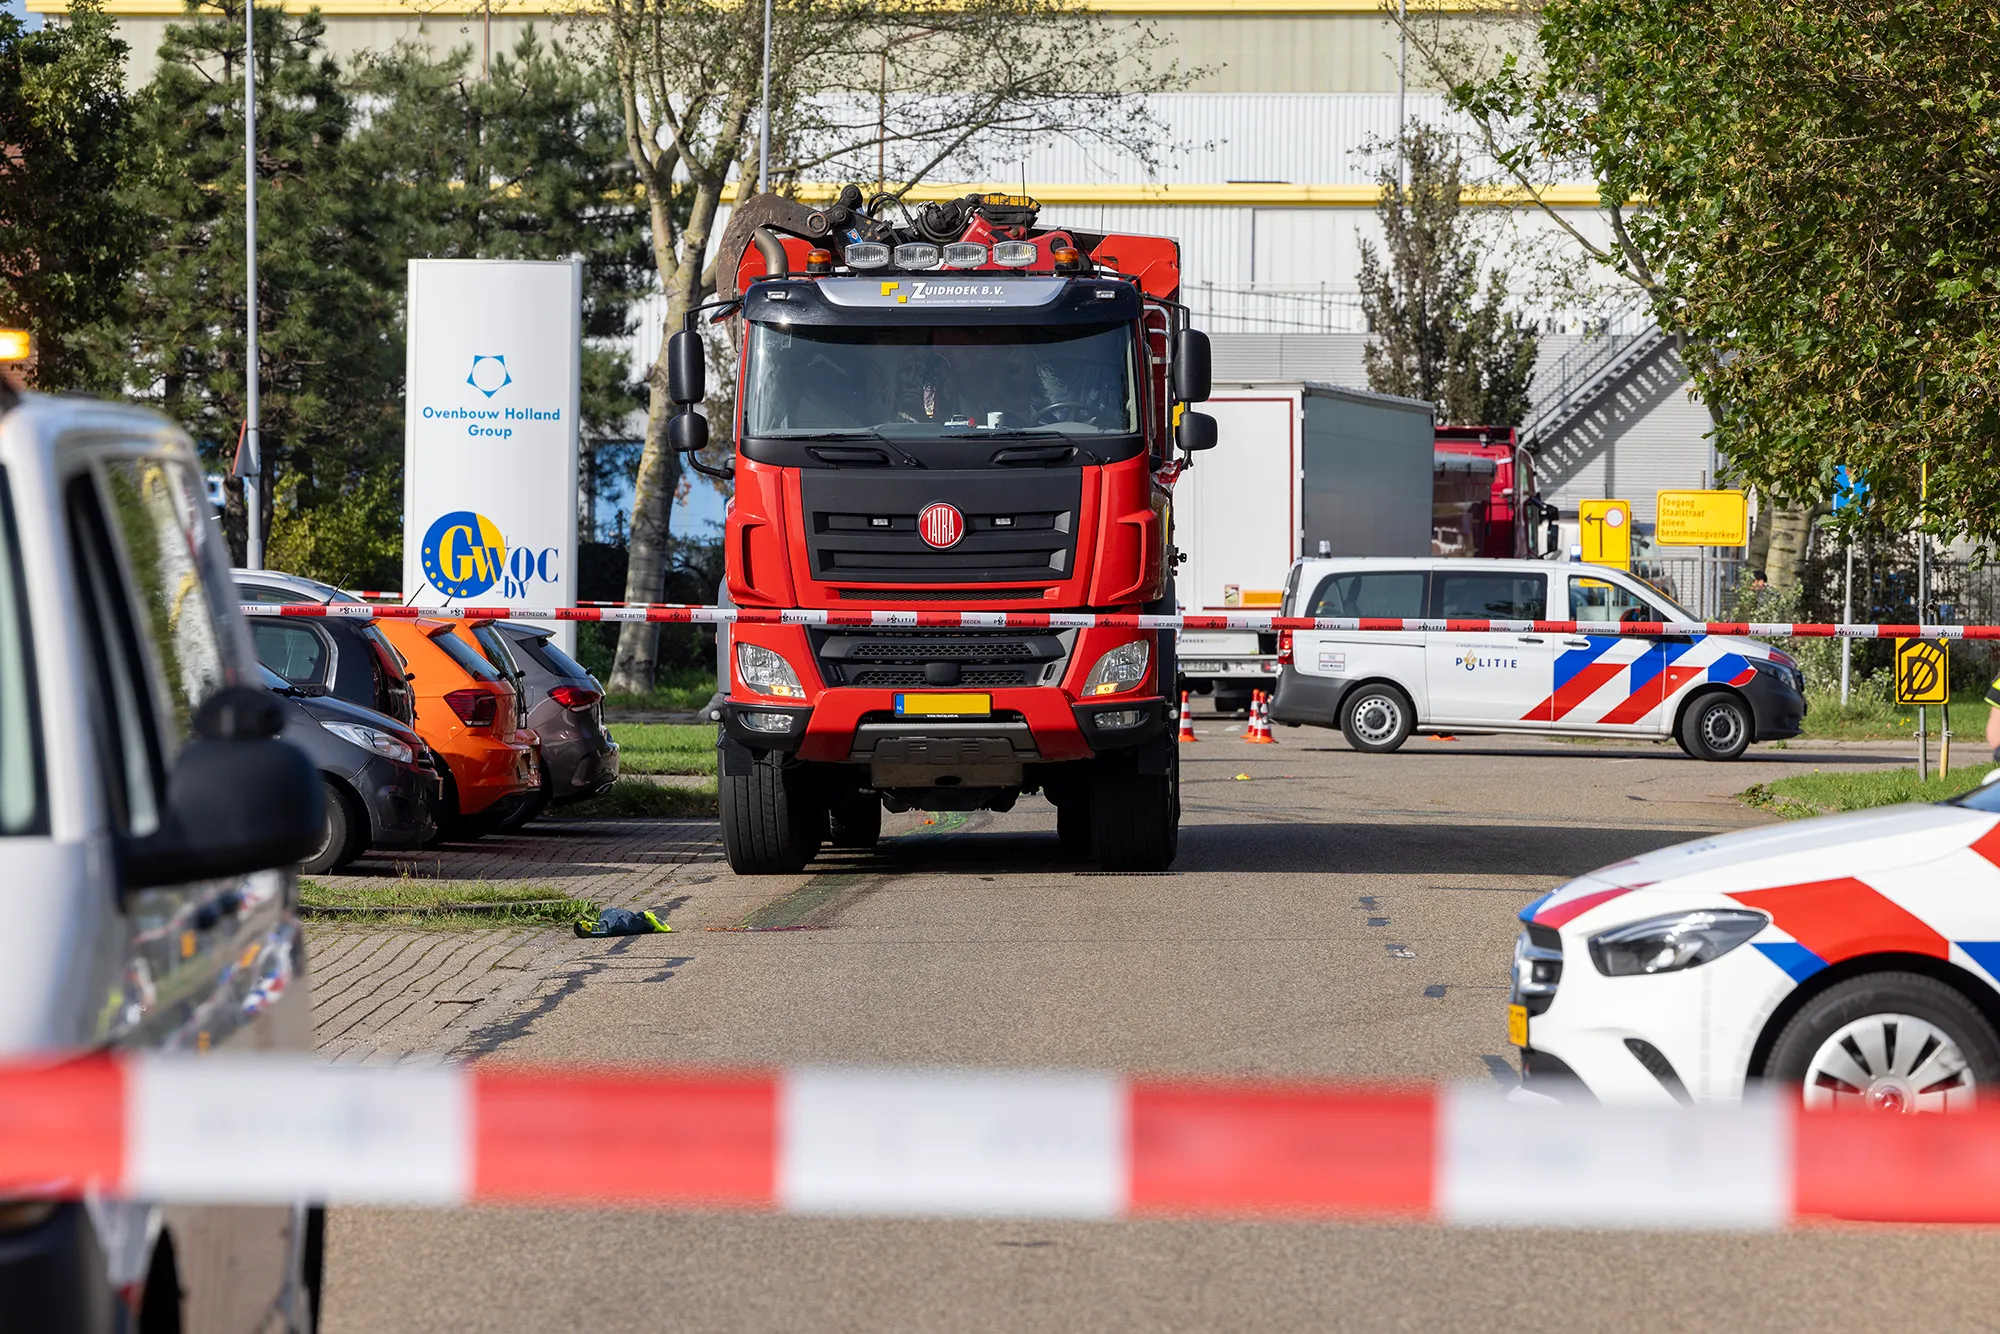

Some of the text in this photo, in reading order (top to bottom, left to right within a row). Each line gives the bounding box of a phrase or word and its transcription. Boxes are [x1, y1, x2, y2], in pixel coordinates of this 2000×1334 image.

[910, 282, 1004, 299] ZUIDHOEK B.V.
[423, 406, 560, 420] Ovenbouw Holland
[468, 424, 513, 439] Group
[1662, 498, 1695, 508] Toegang
[1662, 509, 1704, 517] Staalstraat
[927, 508, 954, 544] TATRA
[1661, 530, 1739, 540] bestemmingverkeer
[340, 606, 369, 614] POLITIE
[451, 608, 479, 616] POLITIE
[561, 609, 589, 618] POLITIE
[670, 611, 699, 620] POLITIE
[779, 613, 808, 622] POLITIE
[887, 614, 915, 623] POLITIE
[994, 616, 1022, 625] POLITIE
[1456, 657, 1517, 671] POLITIE
